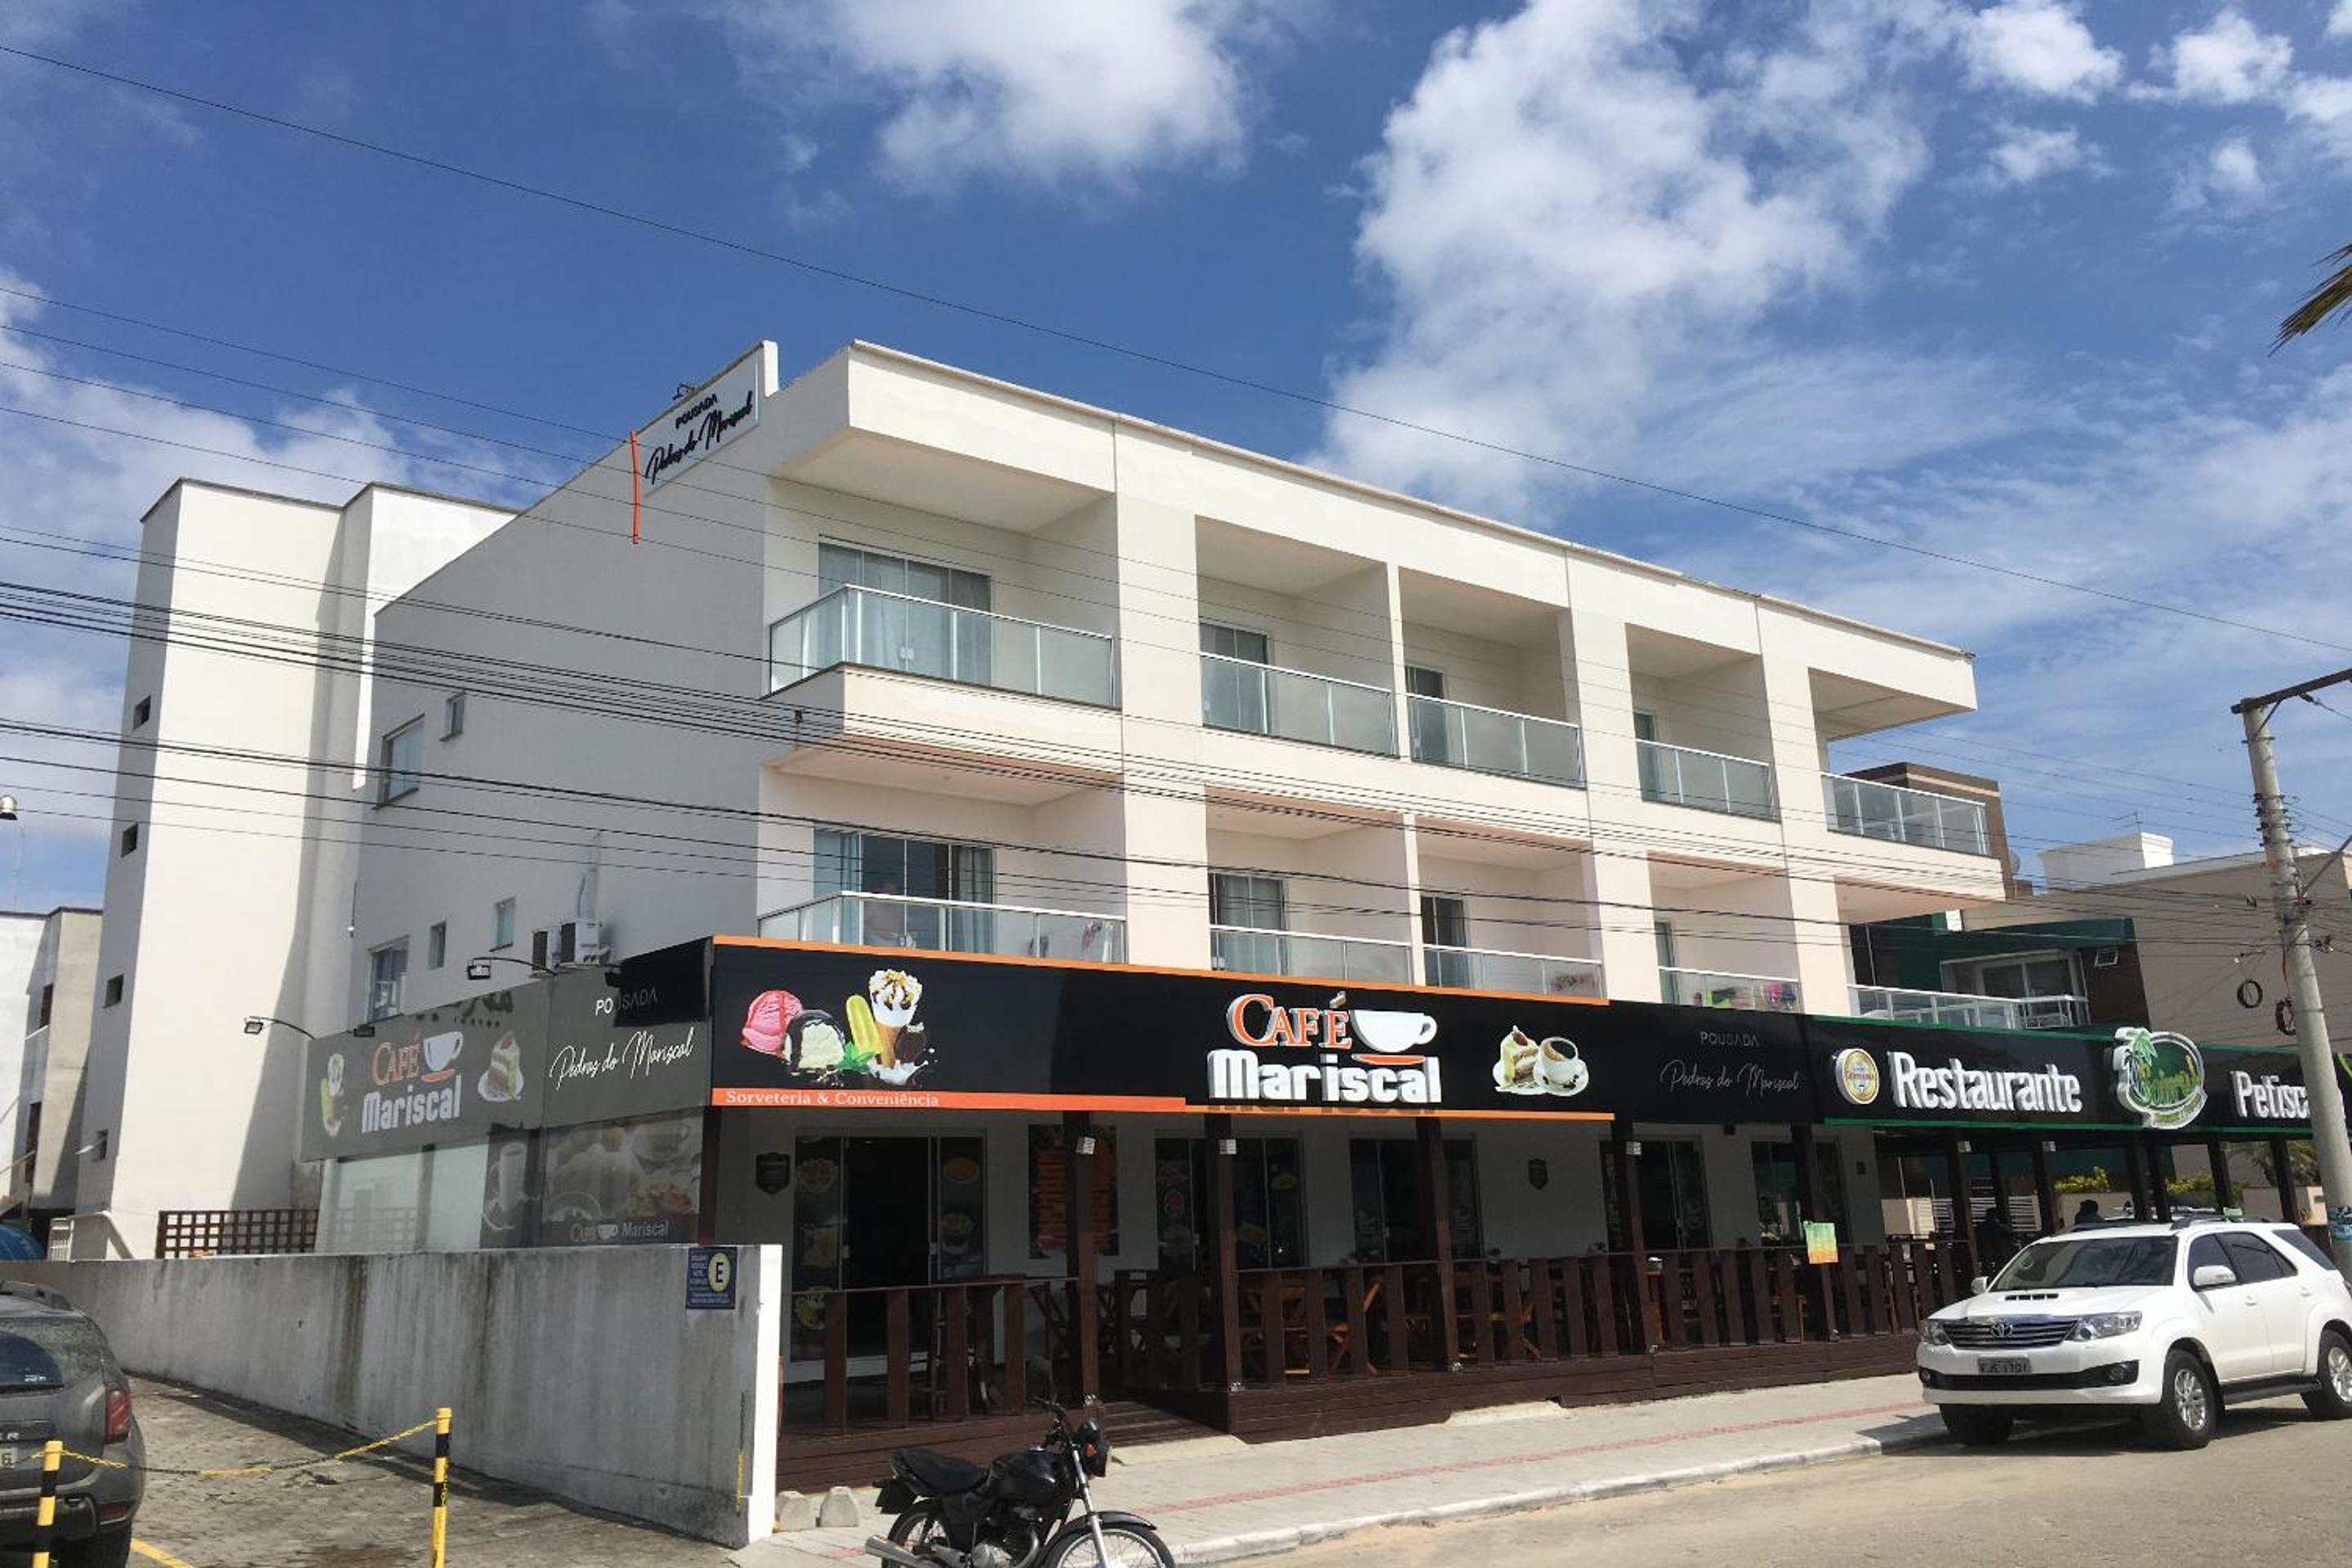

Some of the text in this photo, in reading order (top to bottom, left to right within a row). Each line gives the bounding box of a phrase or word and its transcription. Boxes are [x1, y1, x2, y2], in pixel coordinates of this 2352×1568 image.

[1227, 991, 1352, 1049] CAFÉ
[1699, 1031, 1760, 1047] POUSADA
[548, 1026, 694, 1090] Pedras do Mariscal
[1207, 1049, 1442, 1103] Mariscal
[1659, 1059, 1800, 1098] Pedras do Mariscal
[1886, 1051, 2083, 1113] Restaurante
[361, 1073, 462, 1134] Mariscal
[726, 1091, 940, 1107] Sorveteria & Conveniência
[2230, 1071, 2311, 1119] Petisc
[715, 1262, 724, 1284] E
